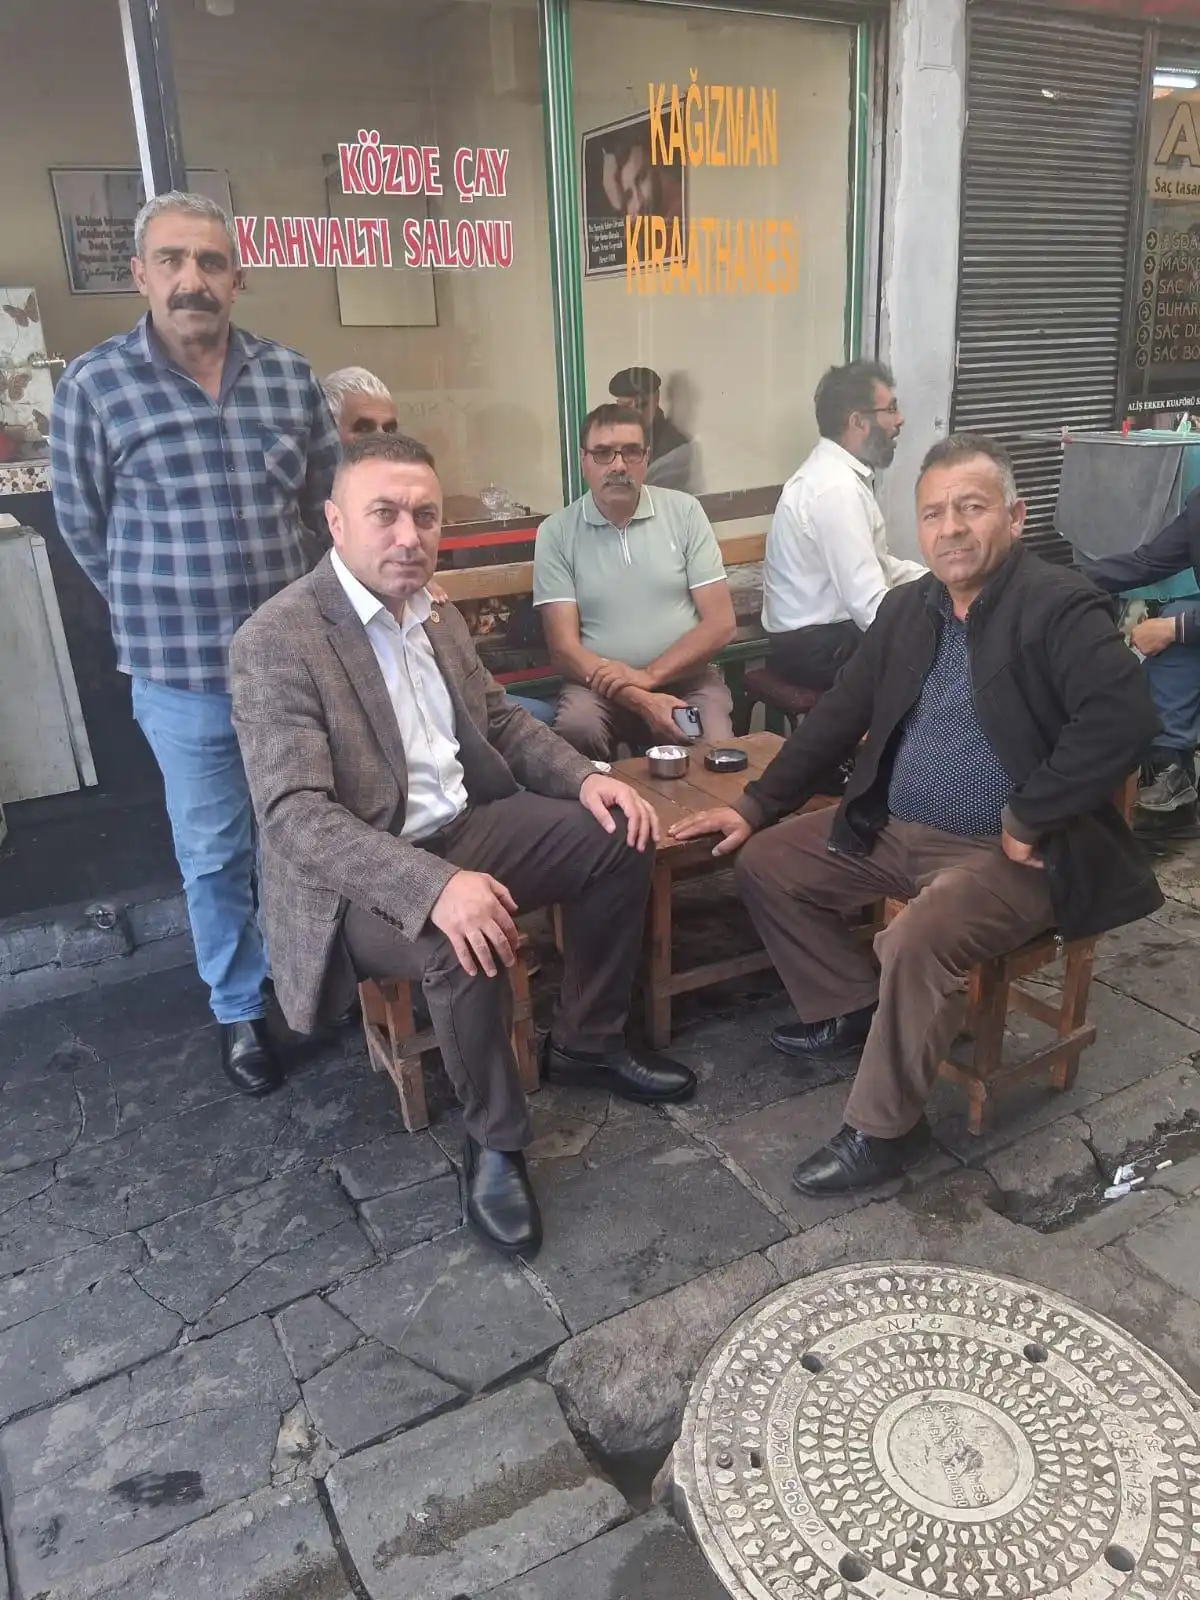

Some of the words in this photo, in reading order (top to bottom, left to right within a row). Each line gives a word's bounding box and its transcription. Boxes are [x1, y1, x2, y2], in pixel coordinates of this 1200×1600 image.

[648, 67, 778, 167] KAĞIZMAN
[337, 129, 443, 197] KÖZDE
[454, 148, 510, 203] ÇAY
[1154, 176, 1172, 198] Saç
[236, 216, 393, 269] KAHVALTI
[403, 218, 514, 269] SALONU
[625, 215, 799, 296] KIRAATHANESİ
[1144, 400, 1166, 410] ERKEK
[1166, 396, 1195, 408] KUAFÖRÜ
[771, 1418, 792, 1468] D400
[779, 1479, 810, 1516] 695
